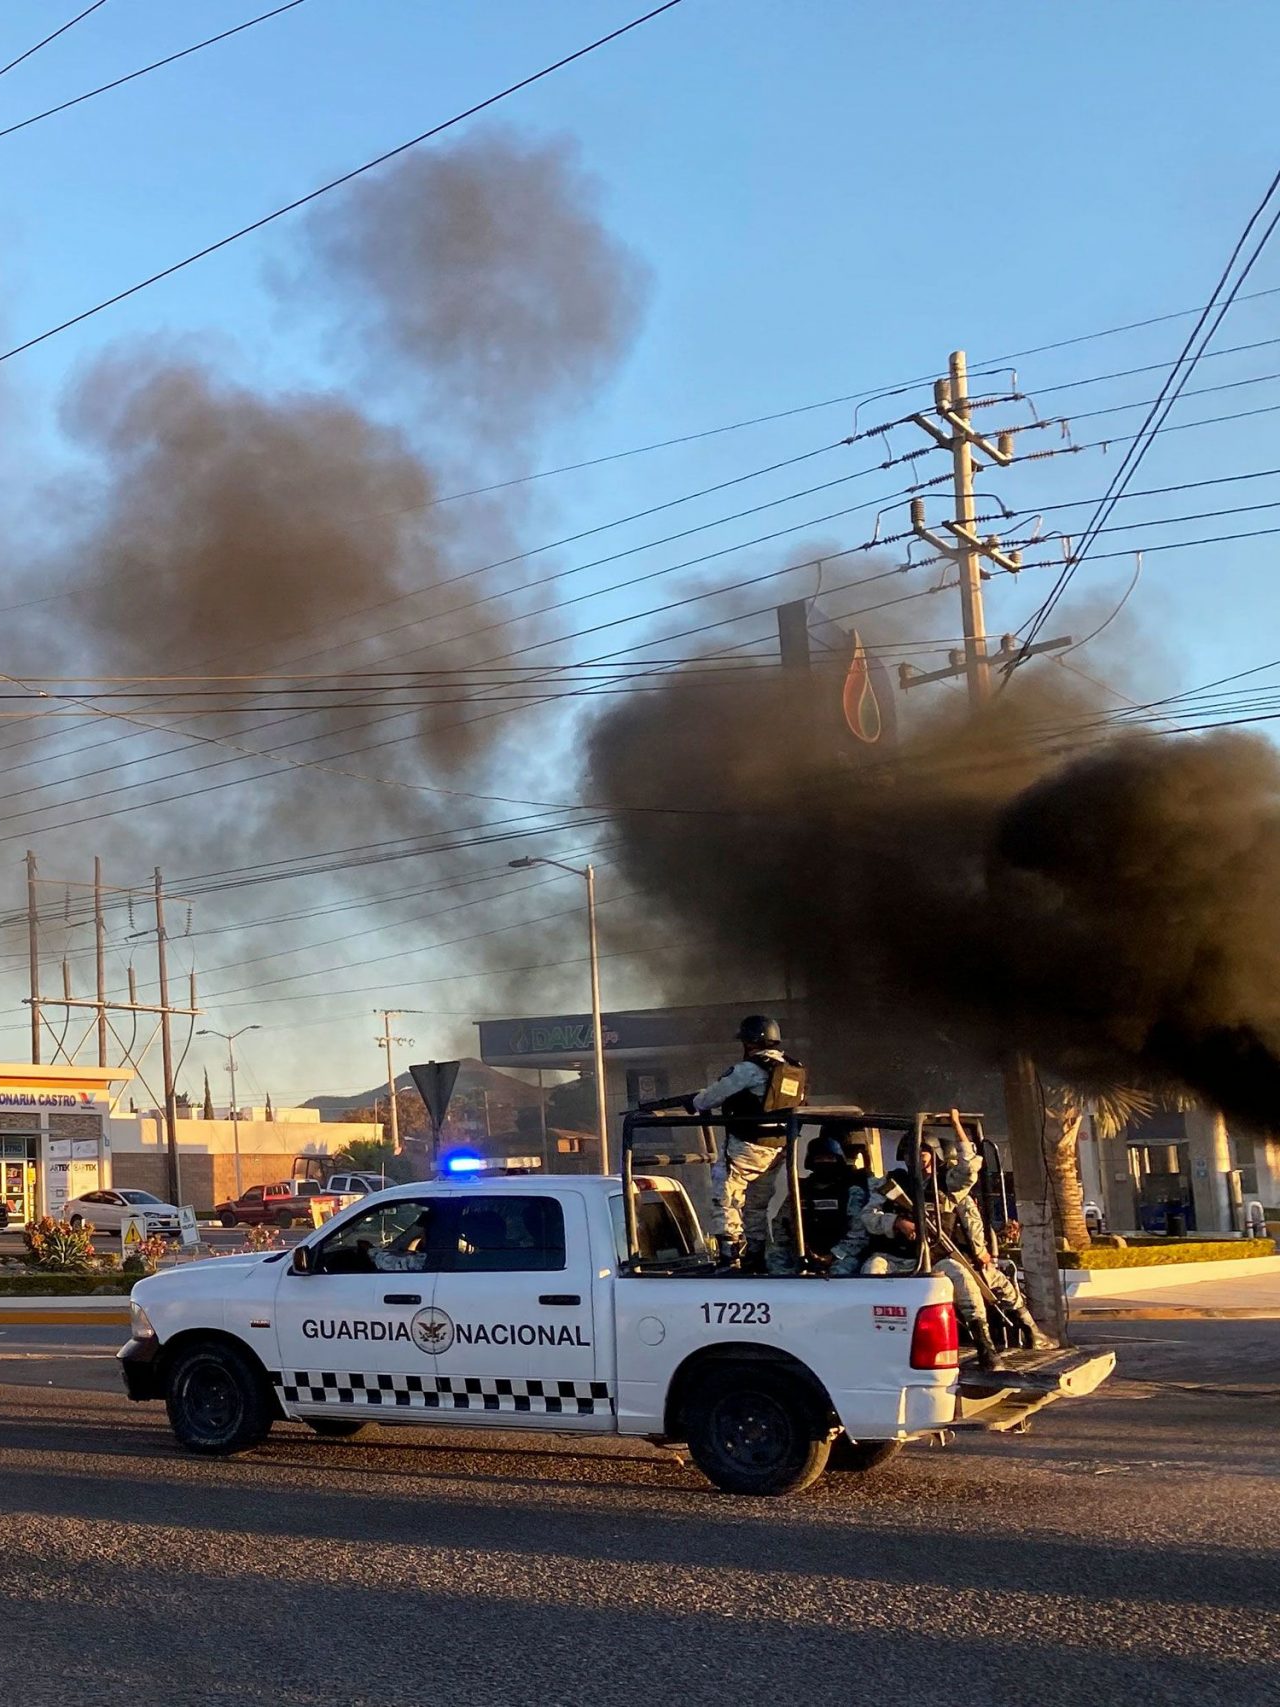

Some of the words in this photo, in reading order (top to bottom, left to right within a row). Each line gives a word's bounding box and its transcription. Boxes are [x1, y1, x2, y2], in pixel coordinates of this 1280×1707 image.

[39, 1094, 77, 1107] CASTRO
[700, 1302, 772, 1325] 17223
[875, 1306, 904, 1316] 911
[302, 1318, 411, 1342] GUARDIA
[455, 1322, 591, 1347] NACIONAL
